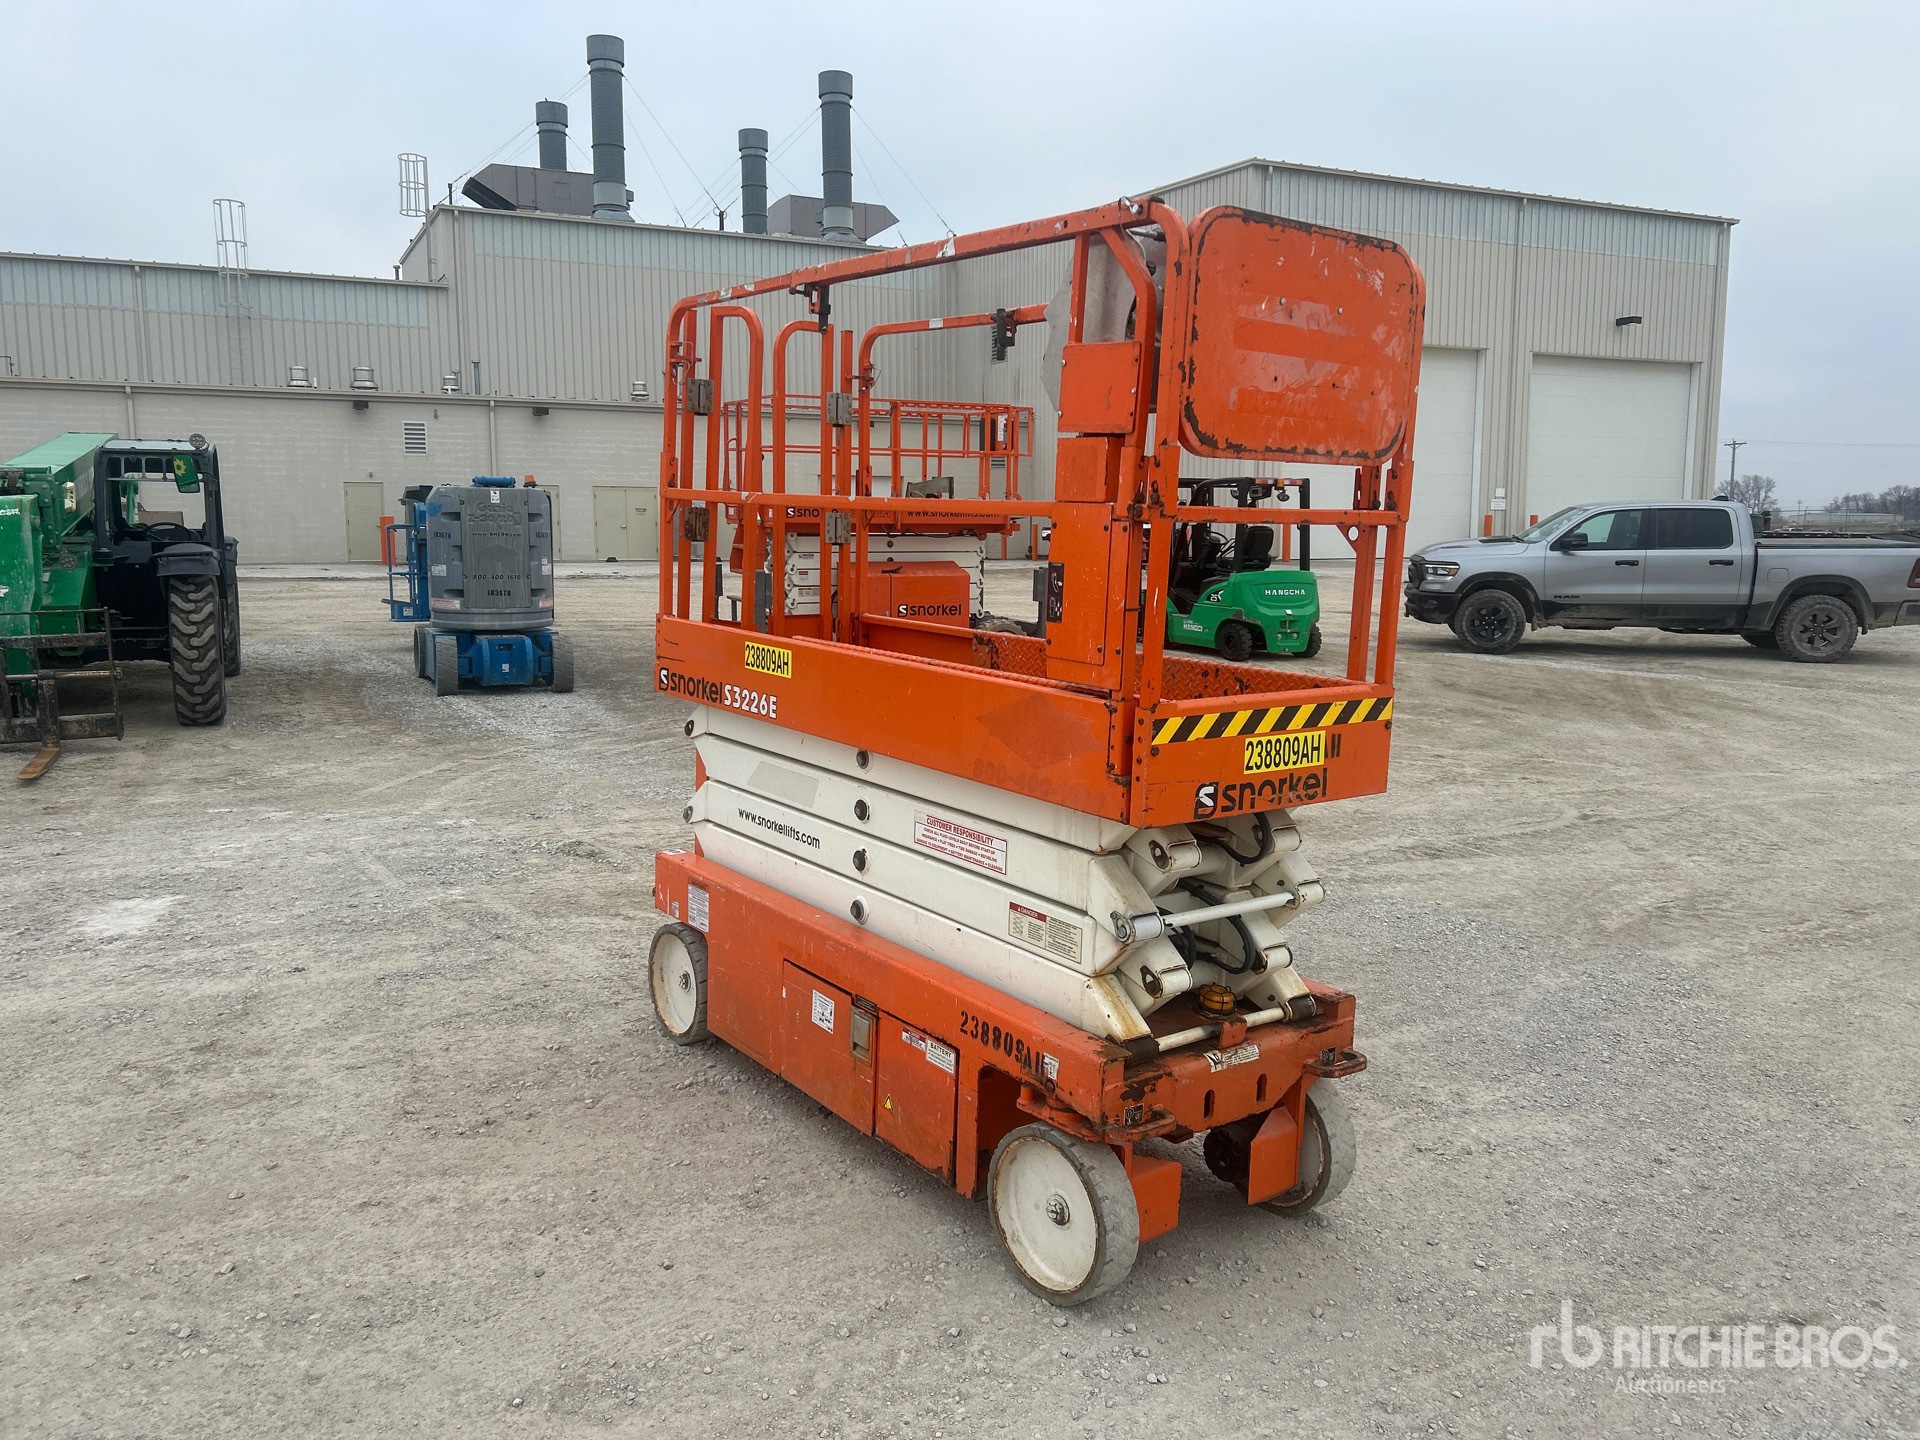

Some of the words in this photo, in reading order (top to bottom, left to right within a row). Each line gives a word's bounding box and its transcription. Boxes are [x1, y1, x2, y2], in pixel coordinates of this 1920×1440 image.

[910, 604, 962, 616] snorkel
[745, 644, 790, 676] 238809AH
[670, 672, 722, 704] snorkel
[724, 684, 778, 720] S3226E
[1245, 734, 1322, 771] 238809AH
[1222, 768, 1328, 812] snorkel
[738, 808, 820, 849] www.snorkellifts.com
[926, 817, 952, 832] CUSTOMER
[953, 826, 993, 845] RESPONSIBILITY
[1020, 906, 1038, 918] DANGER
[930, 1042, 952, 1058] BATTERY
